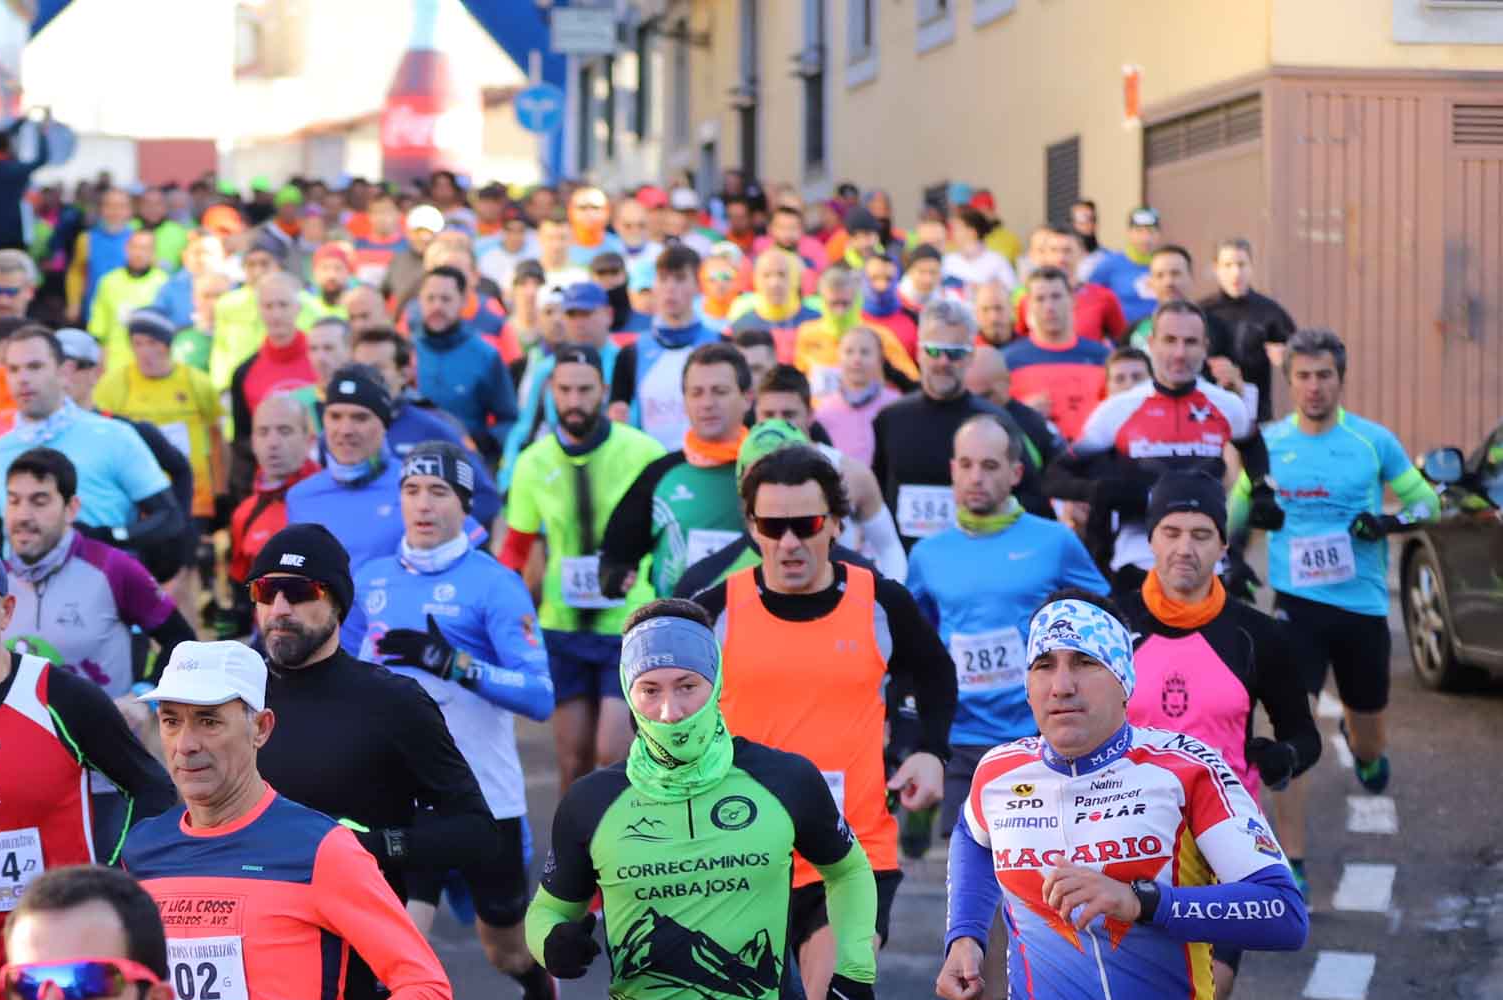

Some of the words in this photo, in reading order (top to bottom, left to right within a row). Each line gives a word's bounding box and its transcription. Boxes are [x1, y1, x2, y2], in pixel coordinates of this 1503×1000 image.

[279, 553, 306, 567] NIKE
[963, 646, 1010, 673] 282
[1090, 778, 1124, 792] Nalini
[1005, 798, 1044, 810] SPD
[1074, 788, 1142, 809] Panaracer
[994, 816, 1058, 831] SHIMANO
[1074, 803, 1146, 825] POLAR
[994, 834, 1163, 870] MACARIO
[616, 852, 771, 880] CORRECAMINOS
[634, 876, 751, 902] CARBAJOSA
[168, 899, 194, 914] LIGA
[195, 899, 237, 914] CROSS
[190, 943, 238, 959] CABRERIZOS
[166, 962, 221, 1000] 02
